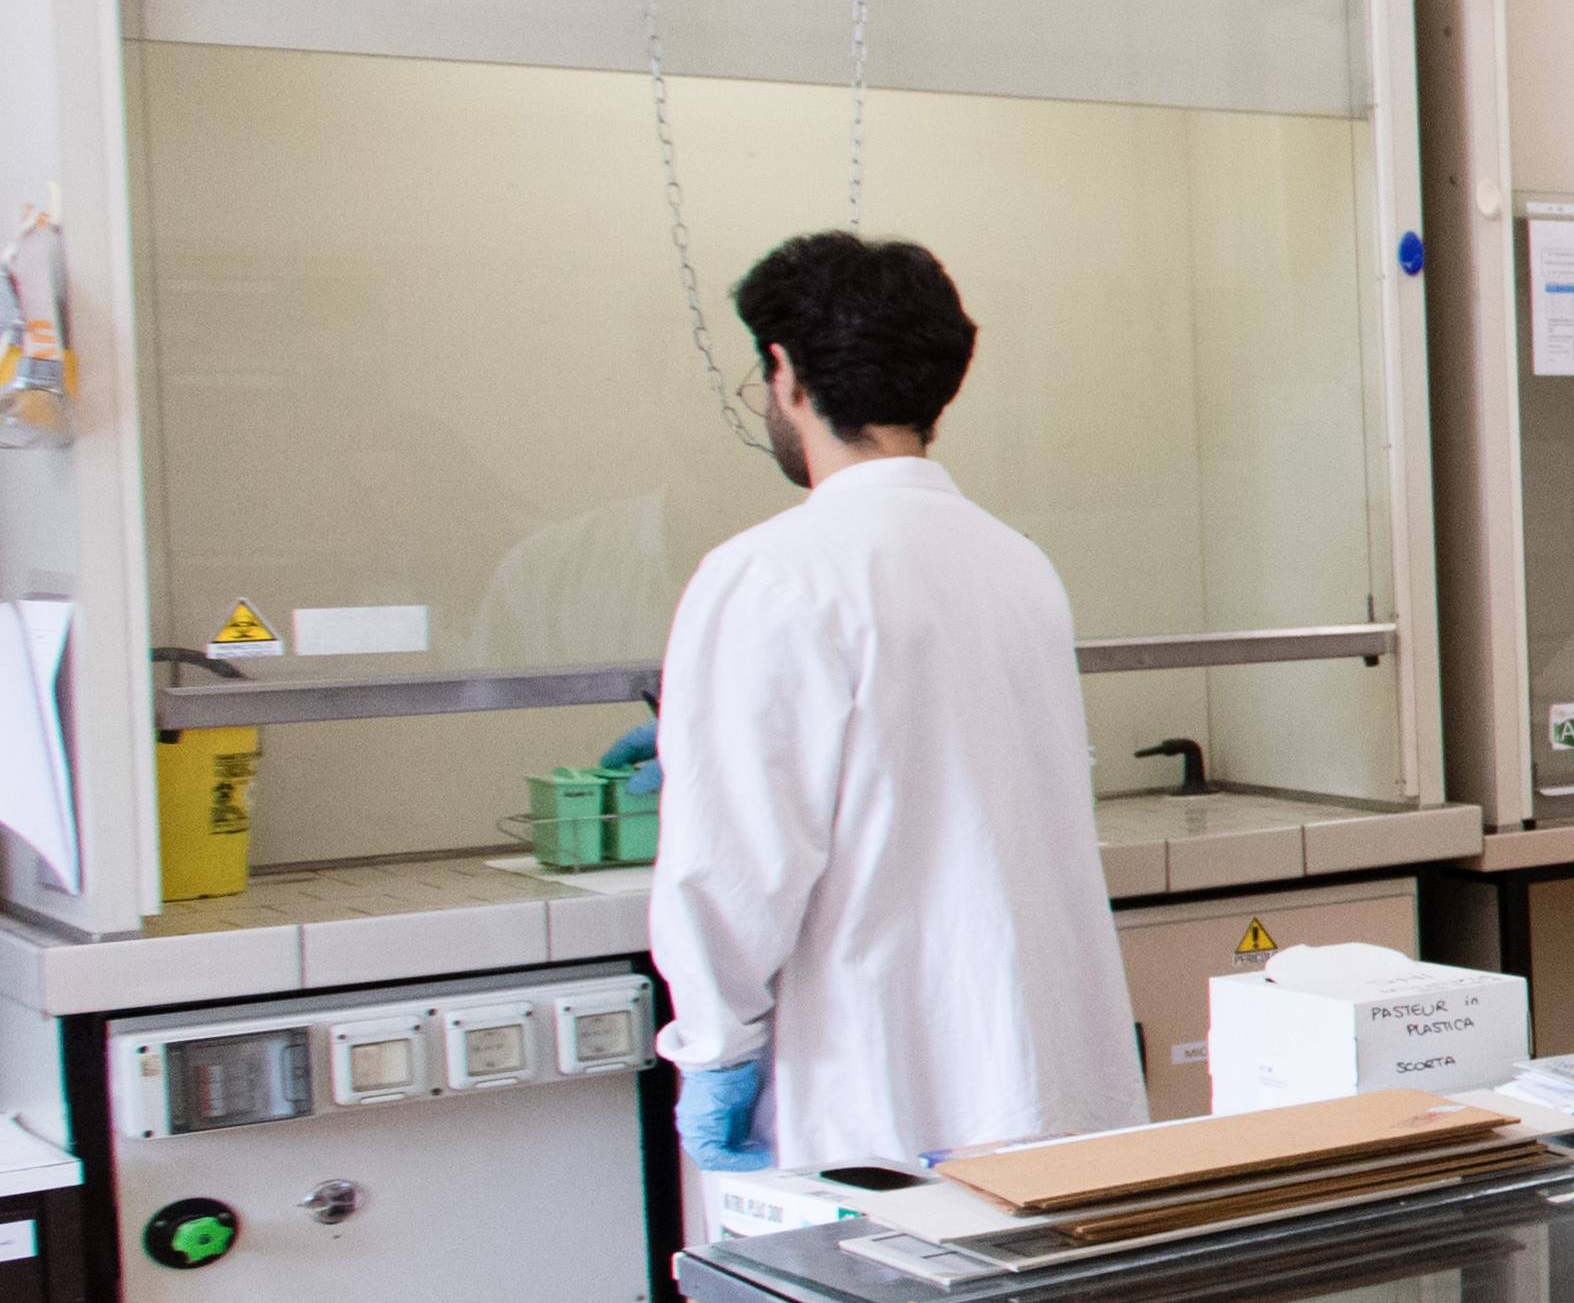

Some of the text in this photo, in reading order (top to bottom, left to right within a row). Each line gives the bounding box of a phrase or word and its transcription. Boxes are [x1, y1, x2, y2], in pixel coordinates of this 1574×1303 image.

[1371, 996, 1479, 1021] PASTEUR in
[1406, 1017, 1475, 1037] PLASTICA
[1395, 1055, 1456, 1074] SCORTA
